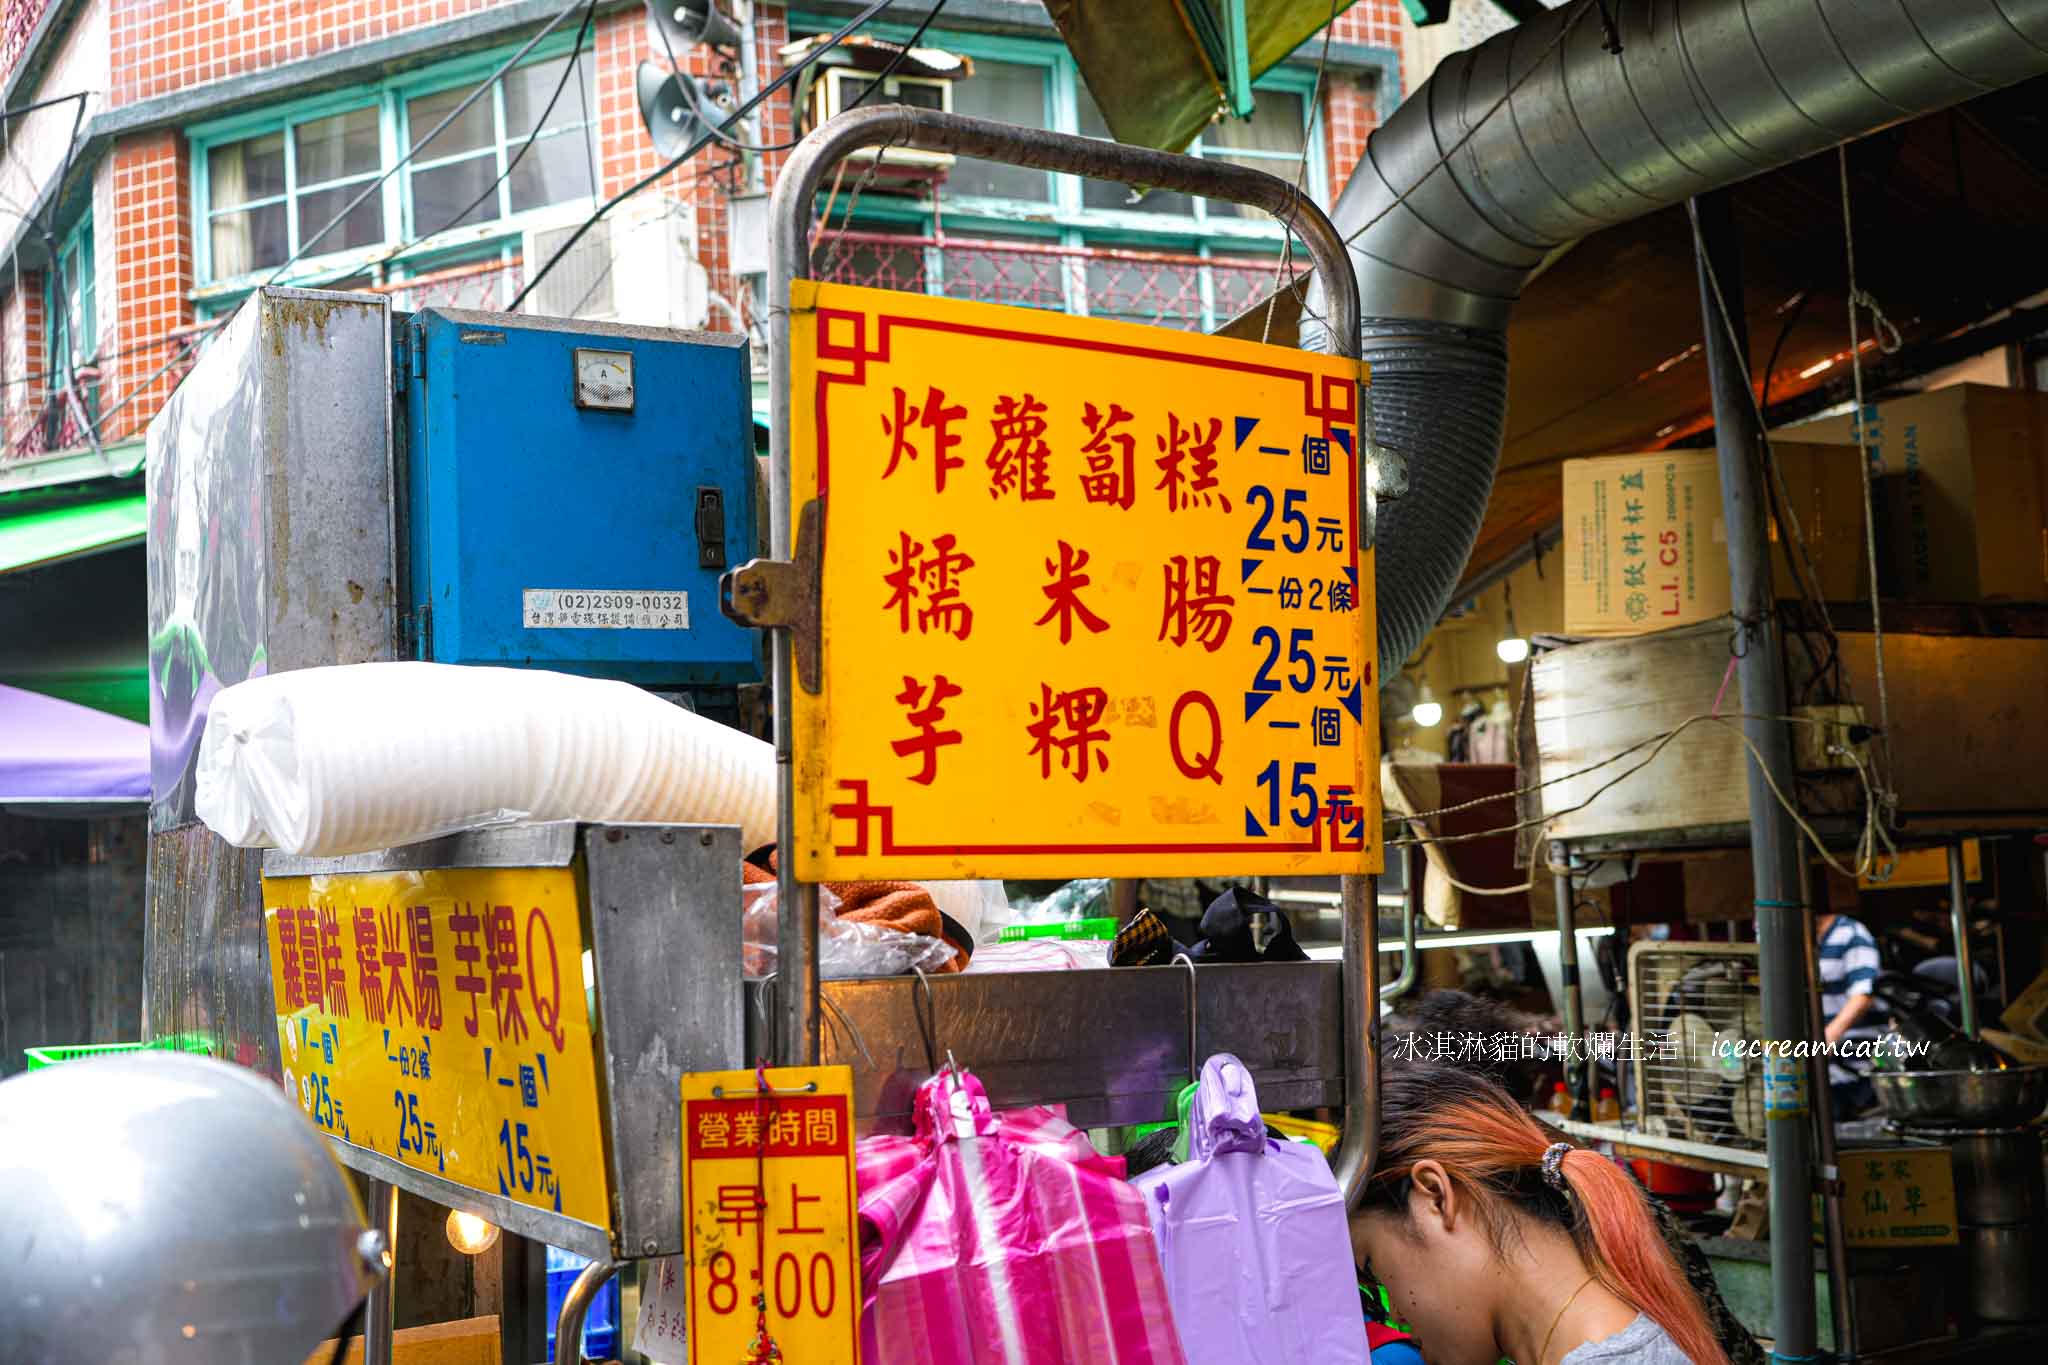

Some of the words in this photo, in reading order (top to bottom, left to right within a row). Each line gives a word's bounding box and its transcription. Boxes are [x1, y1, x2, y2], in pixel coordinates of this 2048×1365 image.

[880, 384, 1232, 514] 炸蘿蔔糕
[1258, 432, 1331, 476] 一個
[1245, 484, 1344, 554] 25元
[1659, 530, 1679, 567] C5
[882, 530, 1236, 653] 糯米腸
[1247, 575, 1353, 614] 一份2條
[1251, 625, 1352, 694] 25元
[890, 675, 1224, 787] 芋粿Q
[1268, 705, 1342, 749] 一個
[1256, 758, 1355, 828] 15元
[276, 904, 350, 1019] 蘿蔔糕
[352, 903, 443, 1031] 糯米腸
[448, 901, 565, 1054] 芋粿Q
[309, 1031, 334, 1065] 一個
[388, 1046, 431, 1080] 一份2條
[310, 1071, 345, 1131] 25元
[498, 1063, 539, 1109] 一個
[395, 1089, 439, 1156] 25元
[698, 1108, 838, 1149] 營業時間
[499, 1118, 555, 1196] 15元
[716, 1183, 825, 1237] 早上
